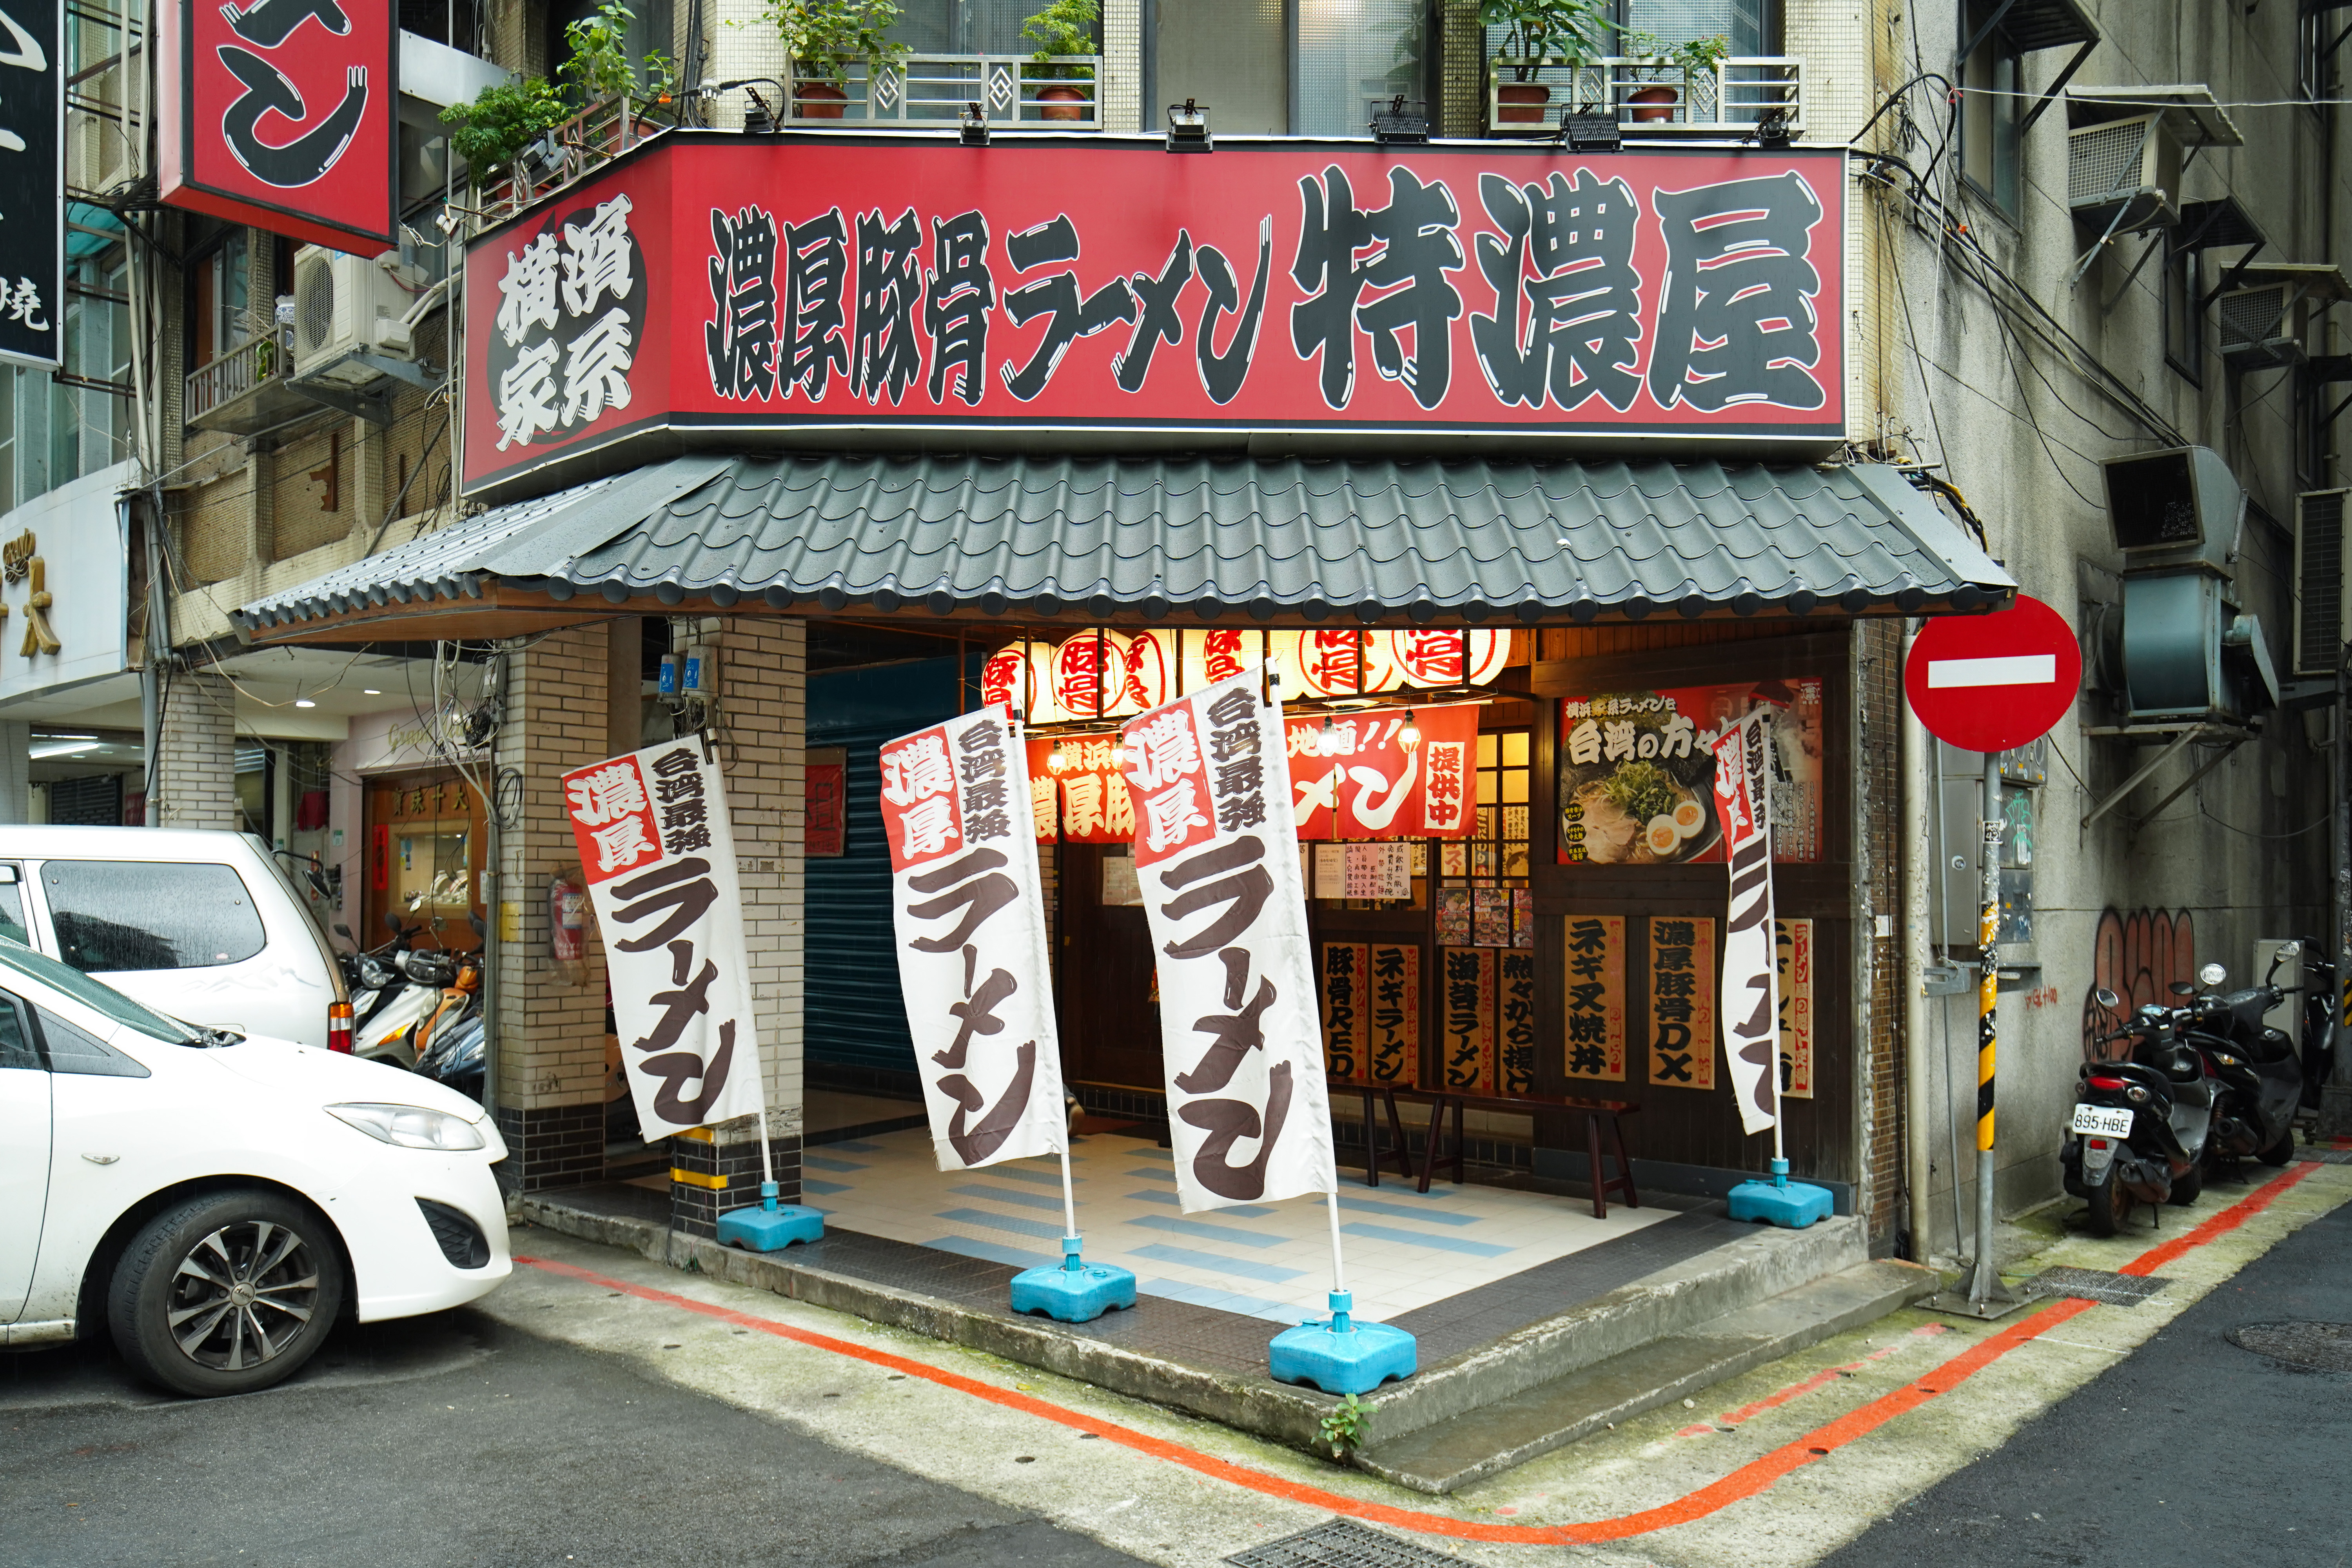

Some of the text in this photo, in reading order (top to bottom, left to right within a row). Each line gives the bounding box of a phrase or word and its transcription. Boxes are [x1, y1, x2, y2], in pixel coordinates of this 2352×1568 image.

[705, 164, 1826, 413] 濃厚豚骨ラーメン 特濃屋
[496, 307, 632, 452] 家系
[1406, 630, 1473, 677] 骨
[1565, 695, 1677, 719] 横浜家系ラーメンを
[651, 747, 712, 856] 台湾最強
[882, 733, 960, 860] 濃厚
[958, 719, 1012, 844] 台湾最強
[1124, 710, 1209, 852] 濃厚
[1206, 687, 1267, 832] 台湾最強
[1427, 746, 1461, 827] 提供中
[1568, 712, 1744, 765] 台湾の方々
[566, 762, 657, 873] 濃厚
[610, 857, 737, 1126] ラーメン
[907, 847, 1036, 1167] ラーメン
[1161, 835, 1293, 1201] ラーメン
[1326, 946, 1354, 1078] 豚骨RED
[1374, 947, 1405, 1081] ネギラーメン
[1446, 951, 1480, 1088] 海苔ラーメン
[1653, 920, 1696, 1082] 濃厚豚骨DX
[2075, 1114, 2129, 1133] 895-HBE
